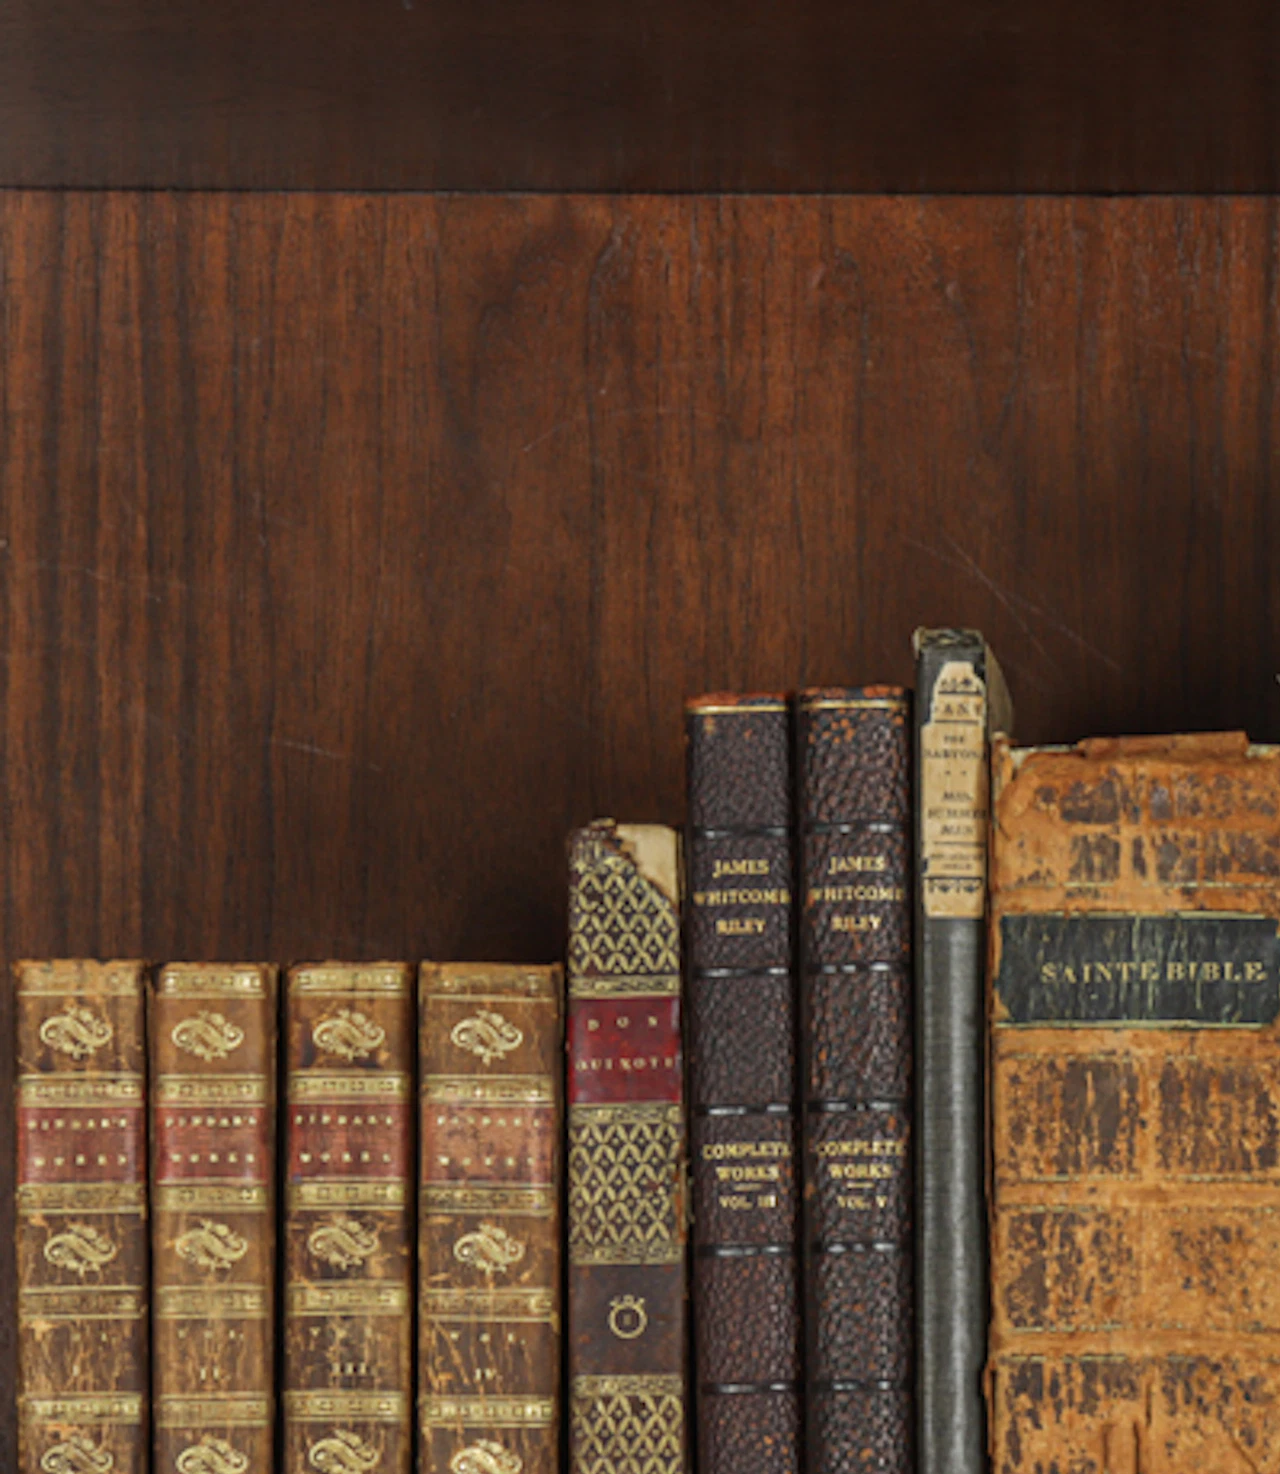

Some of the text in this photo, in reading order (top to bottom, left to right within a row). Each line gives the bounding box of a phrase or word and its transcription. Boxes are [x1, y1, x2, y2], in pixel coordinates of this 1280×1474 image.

[712, 858, 770, 879] JAMES
[828, 856, 885, 876] JAMES
[715, 917, 766, 936] RILEY
[831, 914, 882, 932] RILEY
[1040, 961, 1268, 984] SAINTE BIBLE
[587, 1015, 658, 1032] DON
[575, 1056, 674, 1072] QUIXOTE
[715, 1166, 780, 1182] WORKS
[828, 1163, 893, 1179] WORKS
